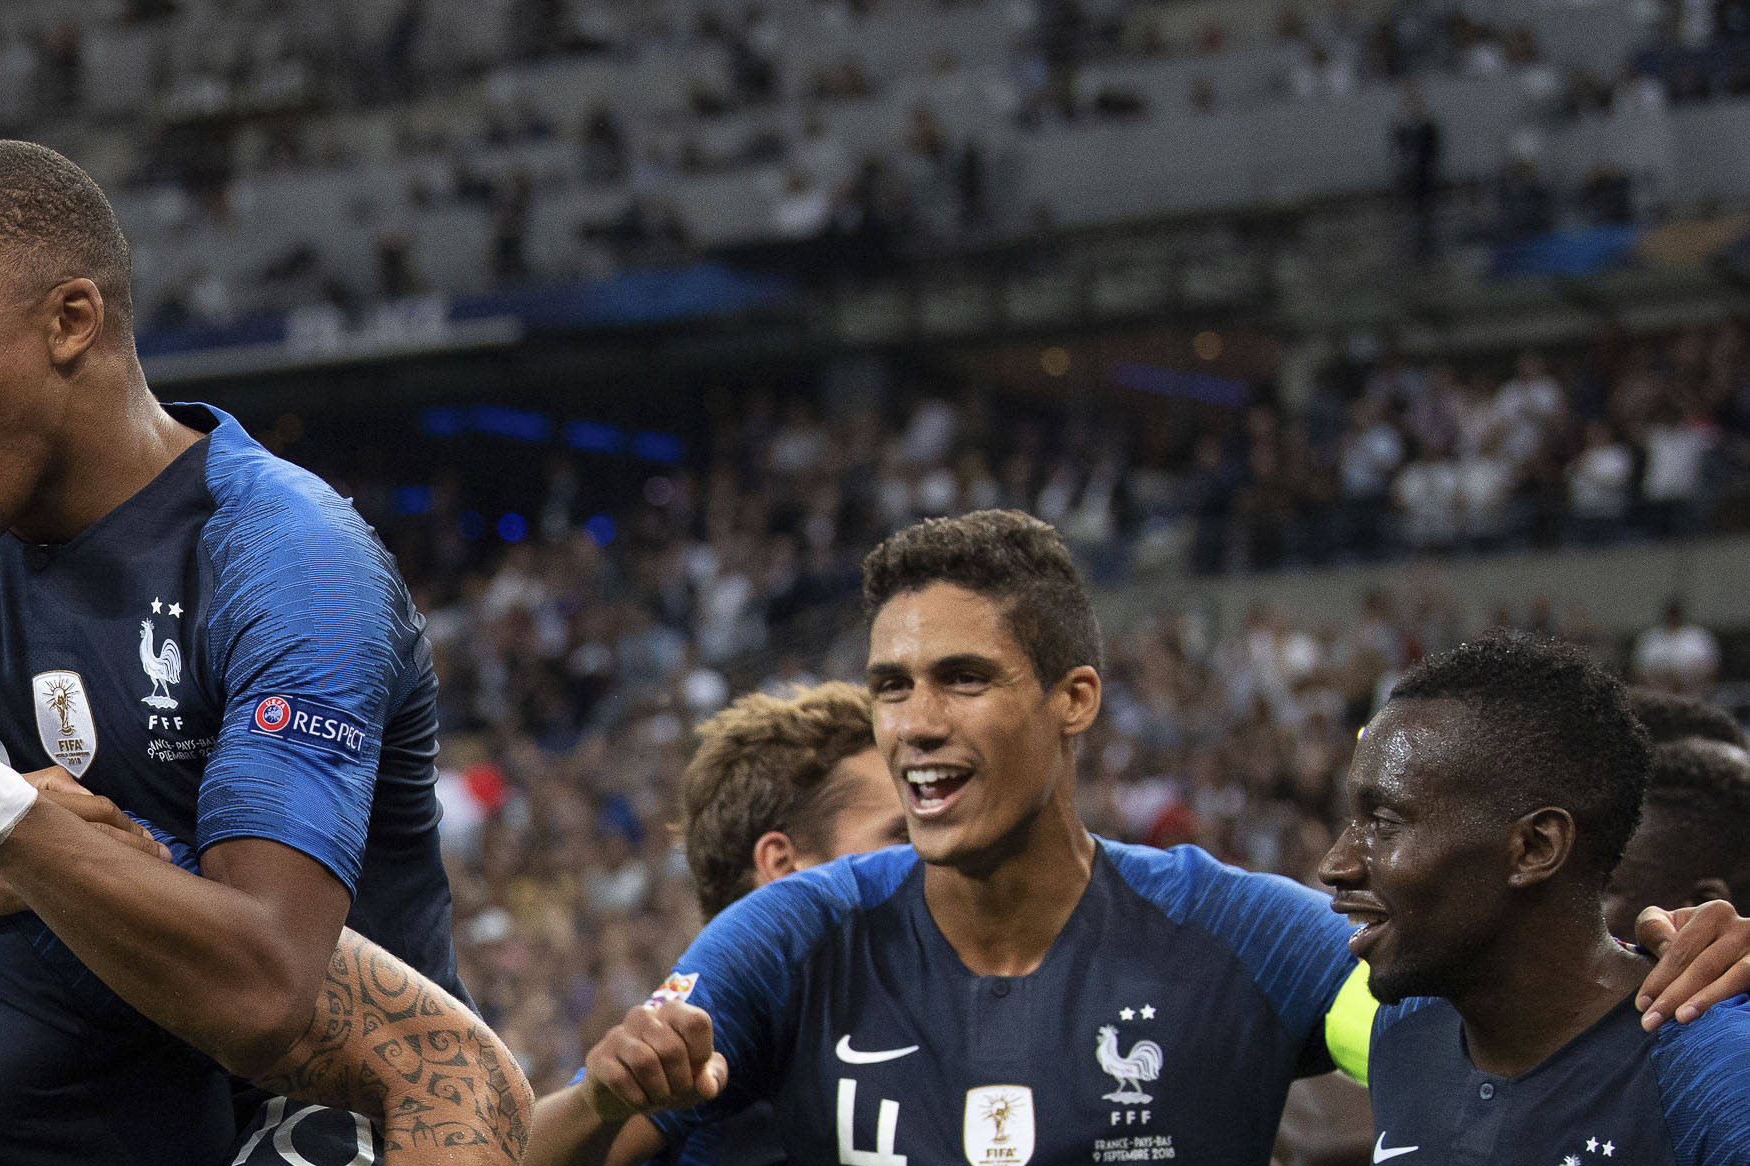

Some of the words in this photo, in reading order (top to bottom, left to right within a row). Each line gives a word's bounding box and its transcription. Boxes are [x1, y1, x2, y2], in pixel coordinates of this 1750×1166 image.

[293, 711, 365, 751] RESPECT
[57, 739, 83, 751] FIFA
[986, 1148, 1016, 1158] FIFA
